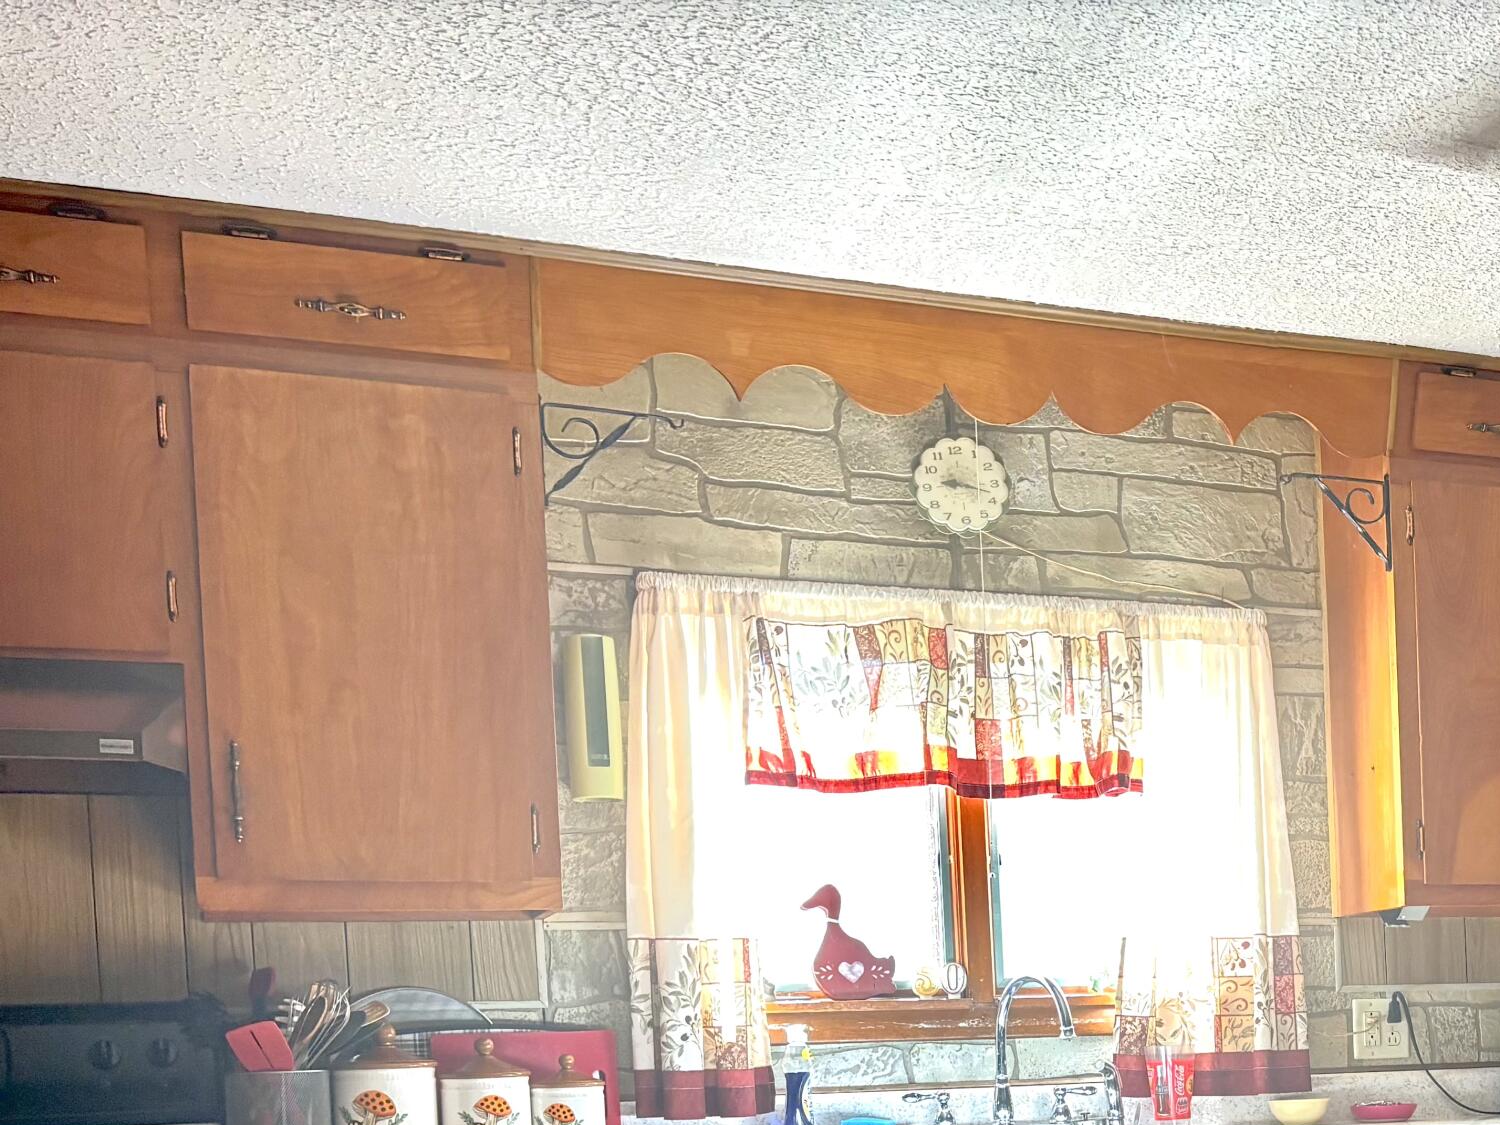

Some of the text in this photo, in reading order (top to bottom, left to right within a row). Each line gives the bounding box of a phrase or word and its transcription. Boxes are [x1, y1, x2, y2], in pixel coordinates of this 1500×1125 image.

[948, 446, 962, 455] 12
[971, 450, 977, 459] 1
[932, 452, 943, 461] 11
[925, 465, 938, 474] 10
[983, 462, 993, 471] 2
[922, 483, 932, 492] 9
[990, 480, 1000, 488] 3
[930, 500, 941, 509] 8
[988, 497, 997, 505] 4
[943, 512, 952, 521] 7
[980, 510, 989, 519] 5
[961, 516, 972, 525] 6
